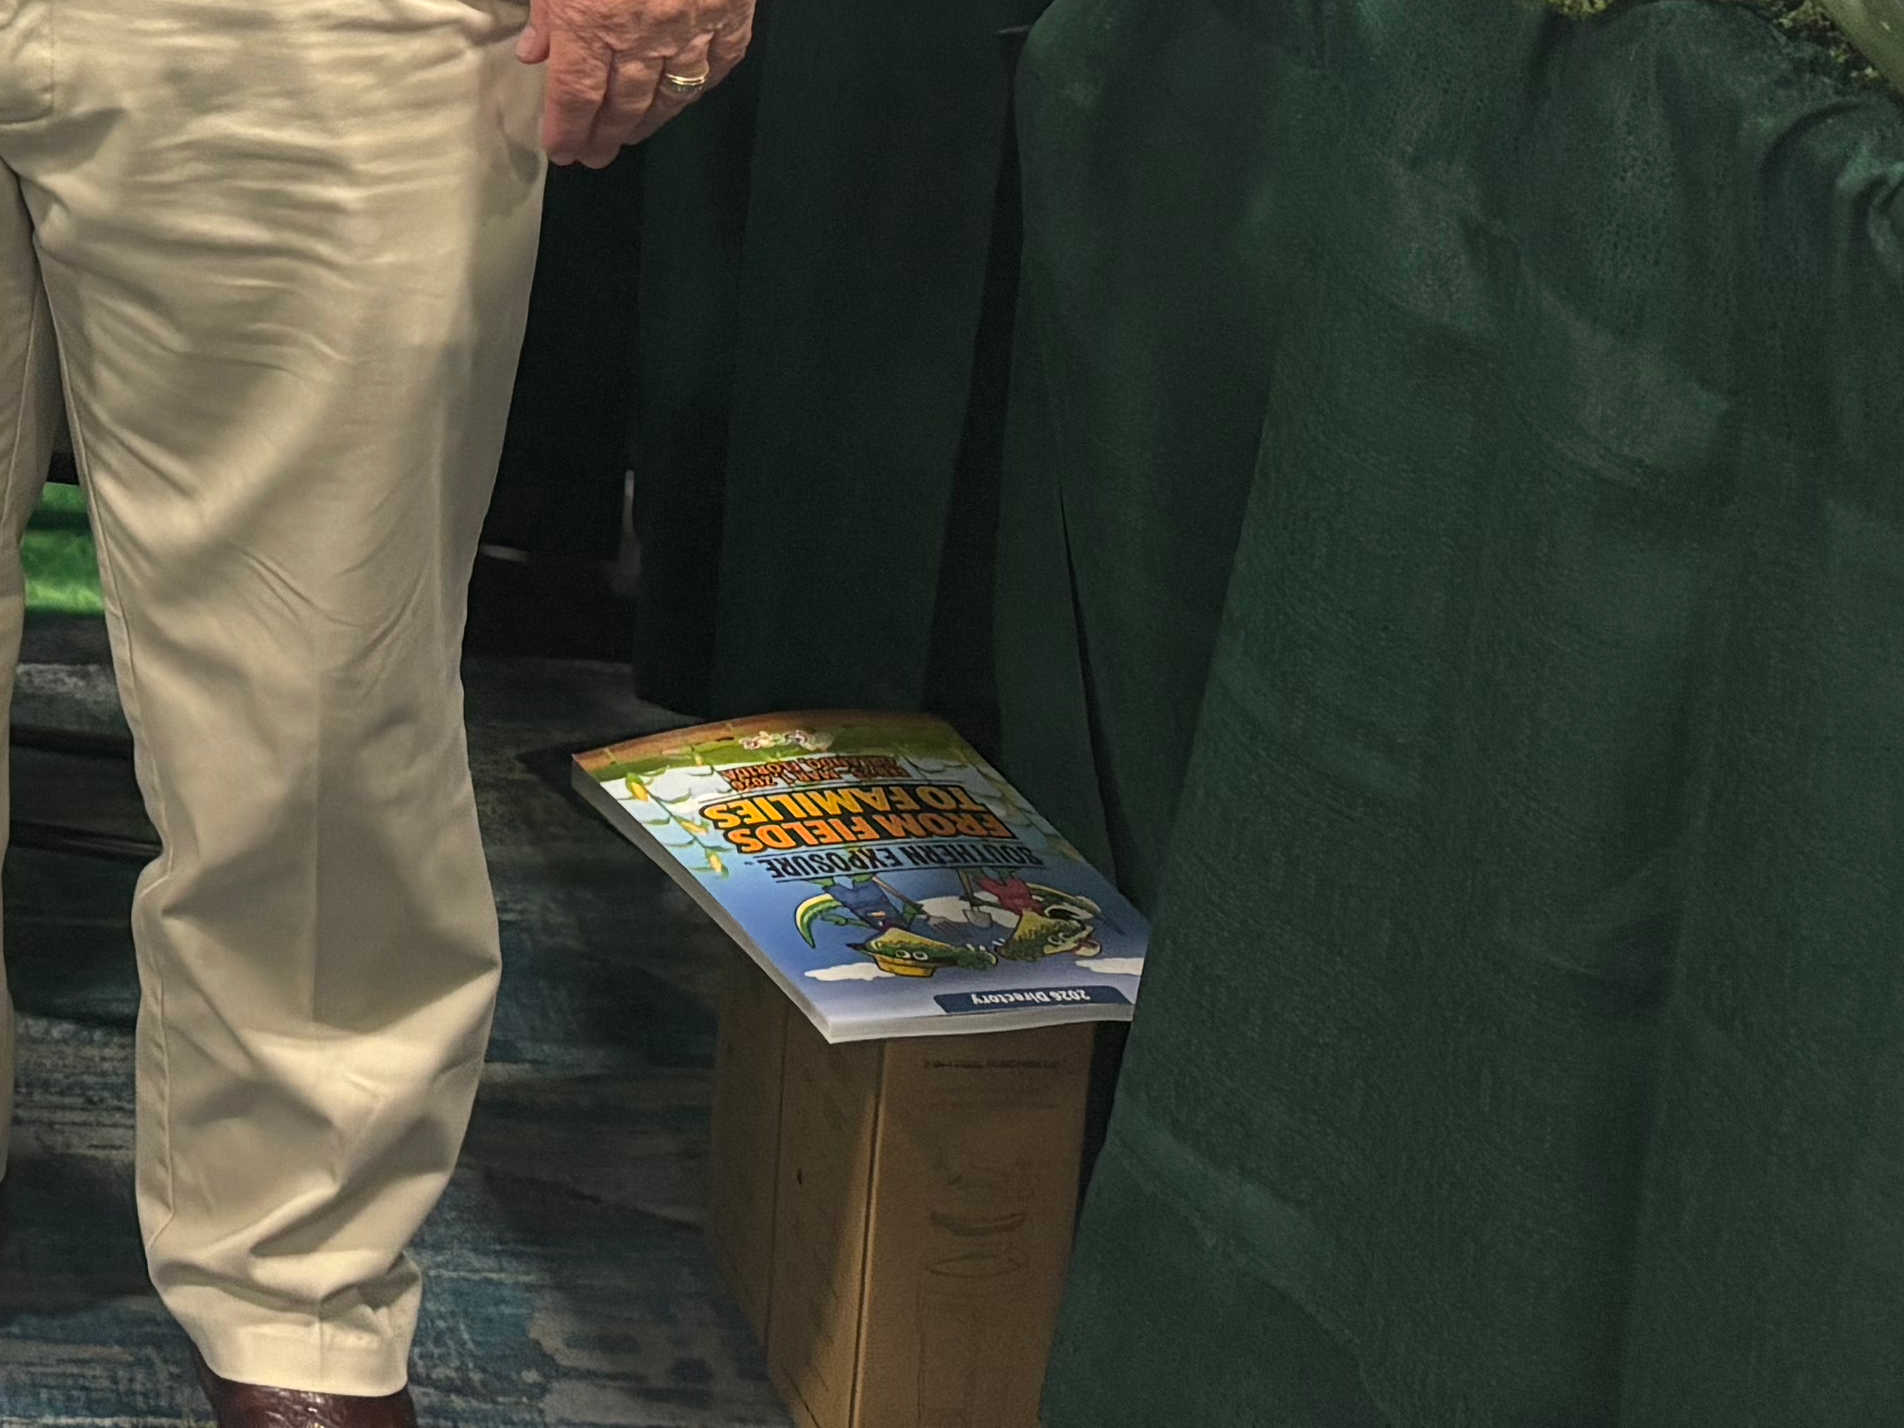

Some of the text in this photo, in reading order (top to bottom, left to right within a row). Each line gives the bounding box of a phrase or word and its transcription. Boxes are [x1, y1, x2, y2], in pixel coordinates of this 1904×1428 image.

[703, 785, 988, 829] TO FAMILIES
[728, 812, 1016, 854] FROM FIELDS
[757, 843, 1044, 879] SOUTHERN EXPOSURE
[970, 989, 1092, 1005] 2026 Directory
